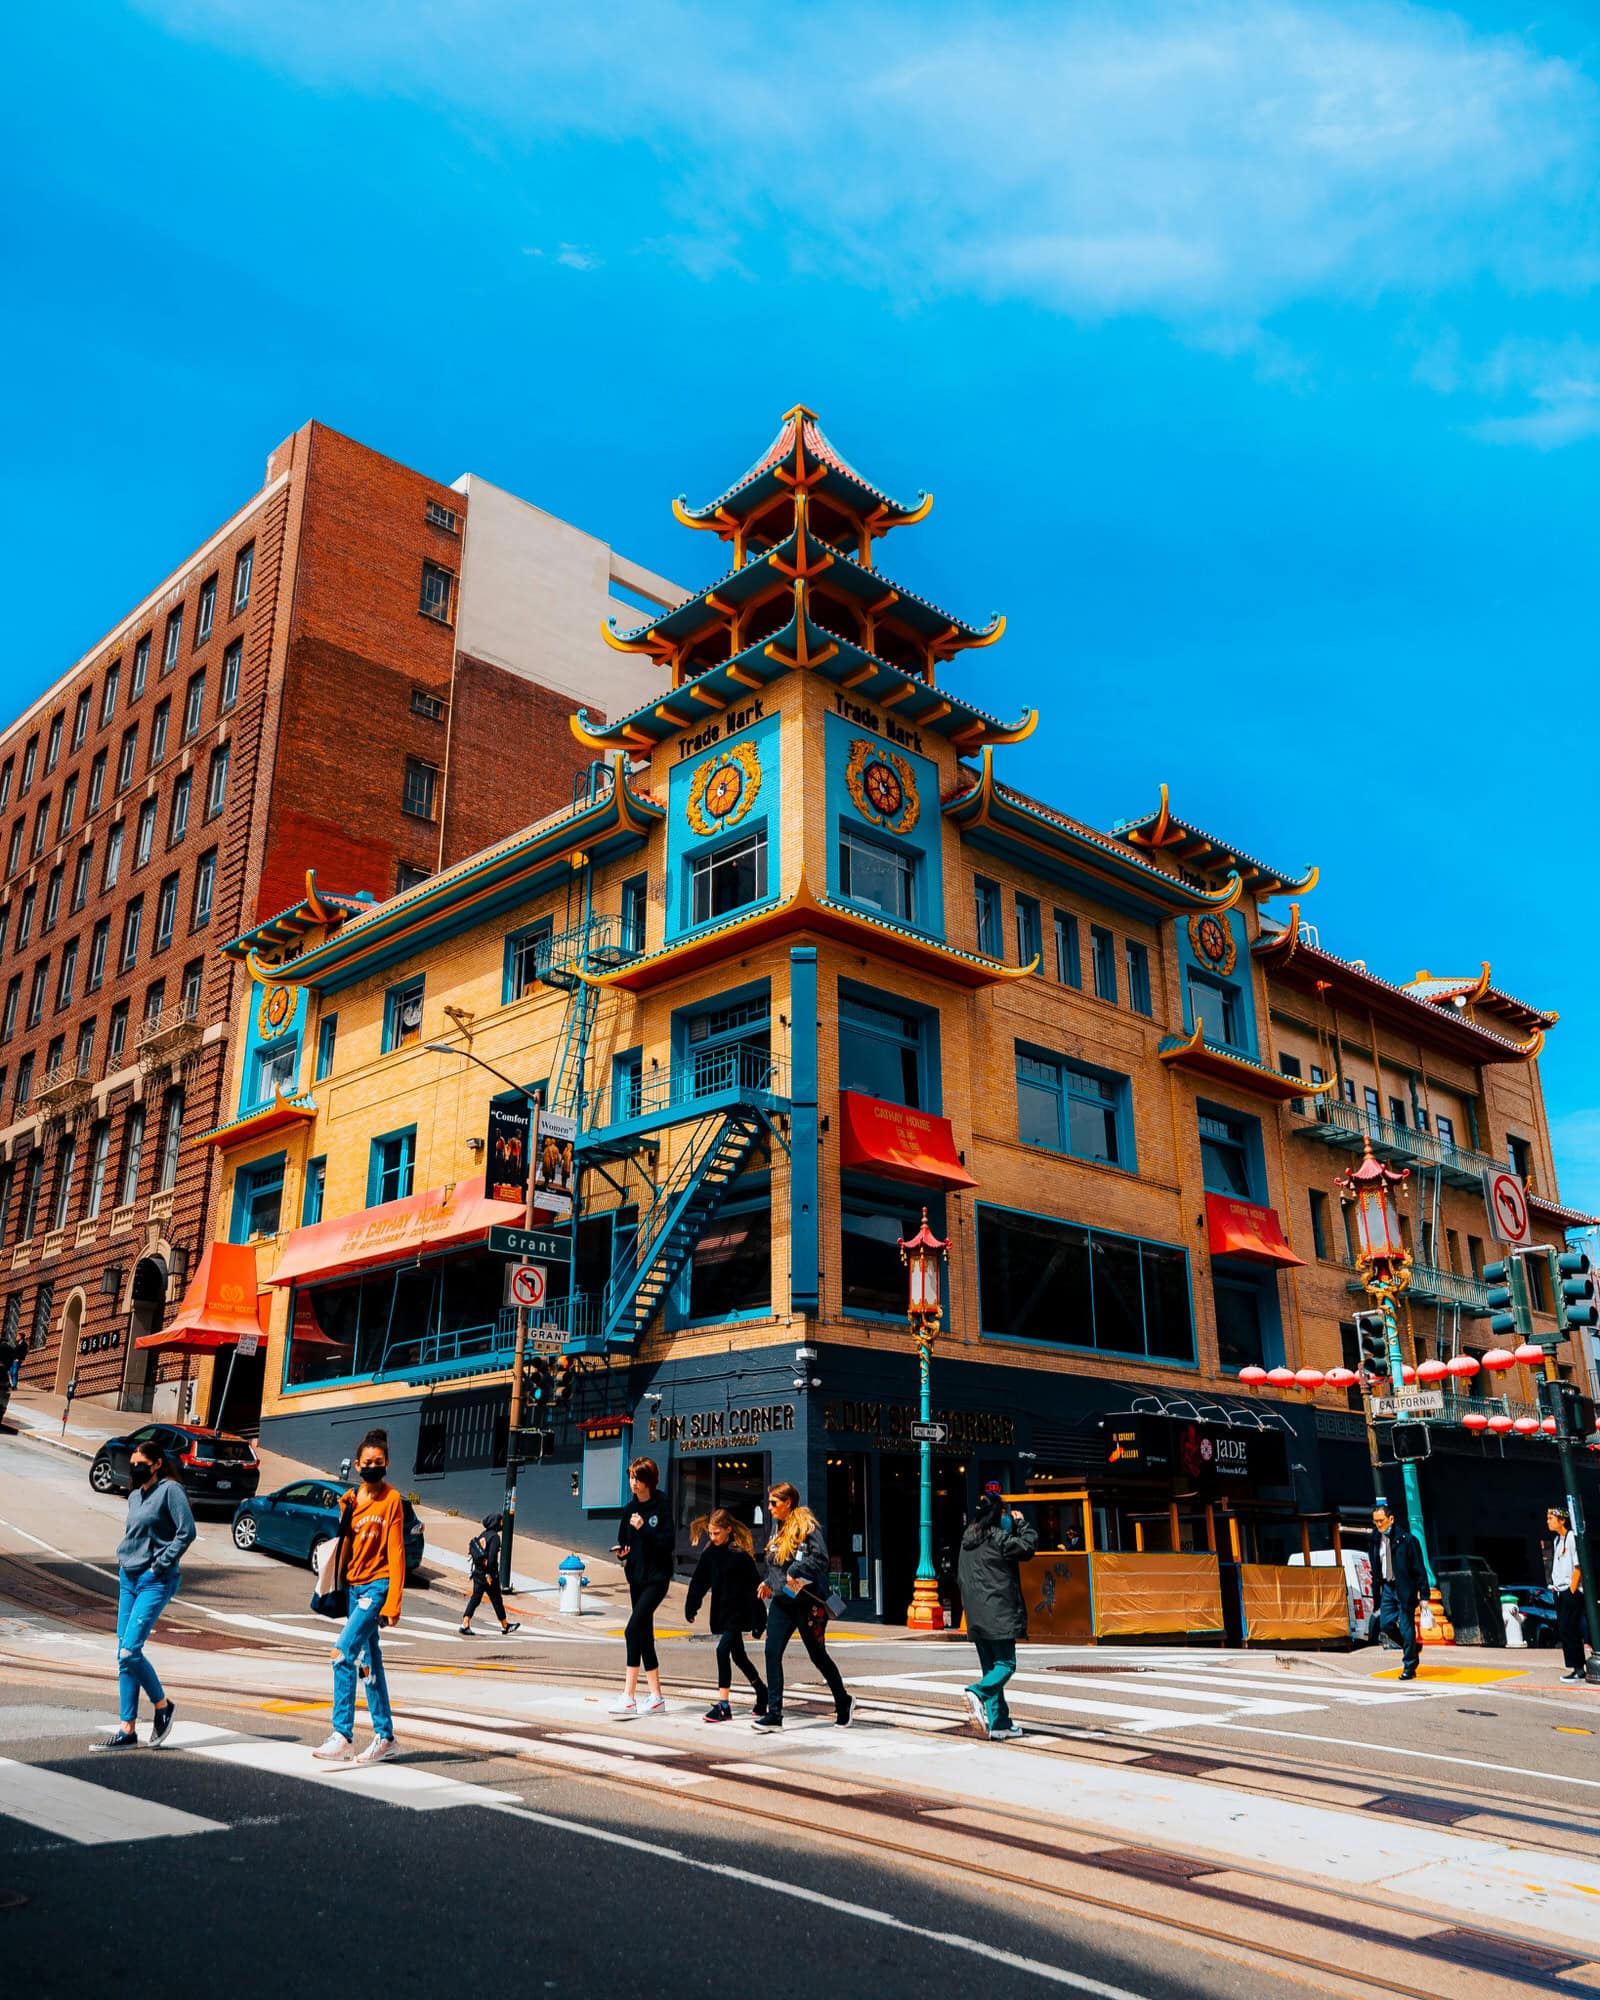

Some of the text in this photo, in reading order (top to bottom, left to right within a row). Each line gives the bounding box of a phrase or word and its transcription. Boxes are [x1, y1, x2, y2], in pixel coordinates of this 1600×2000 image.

[678, 699, 764, 759] Trade Mark
[834, 692, 923, 754] Trade Mark
[874, 1107, 931, 1132] CATHAY HOUSE
[365, 1212, 413, 1239] CATHAY
[507, 1234, 556, 1254] Grant
[530, 1329, 568, 1341] GRANT
[842, 1400, 882, 1432] DIM
[1379, 1396, 1436, 1410] CALIFORNIA
[659, 1414, 686, 1441] DIM
[690, 1411, 725, 1437] SUM
[729, 1404, 795, 1433] CORNER
